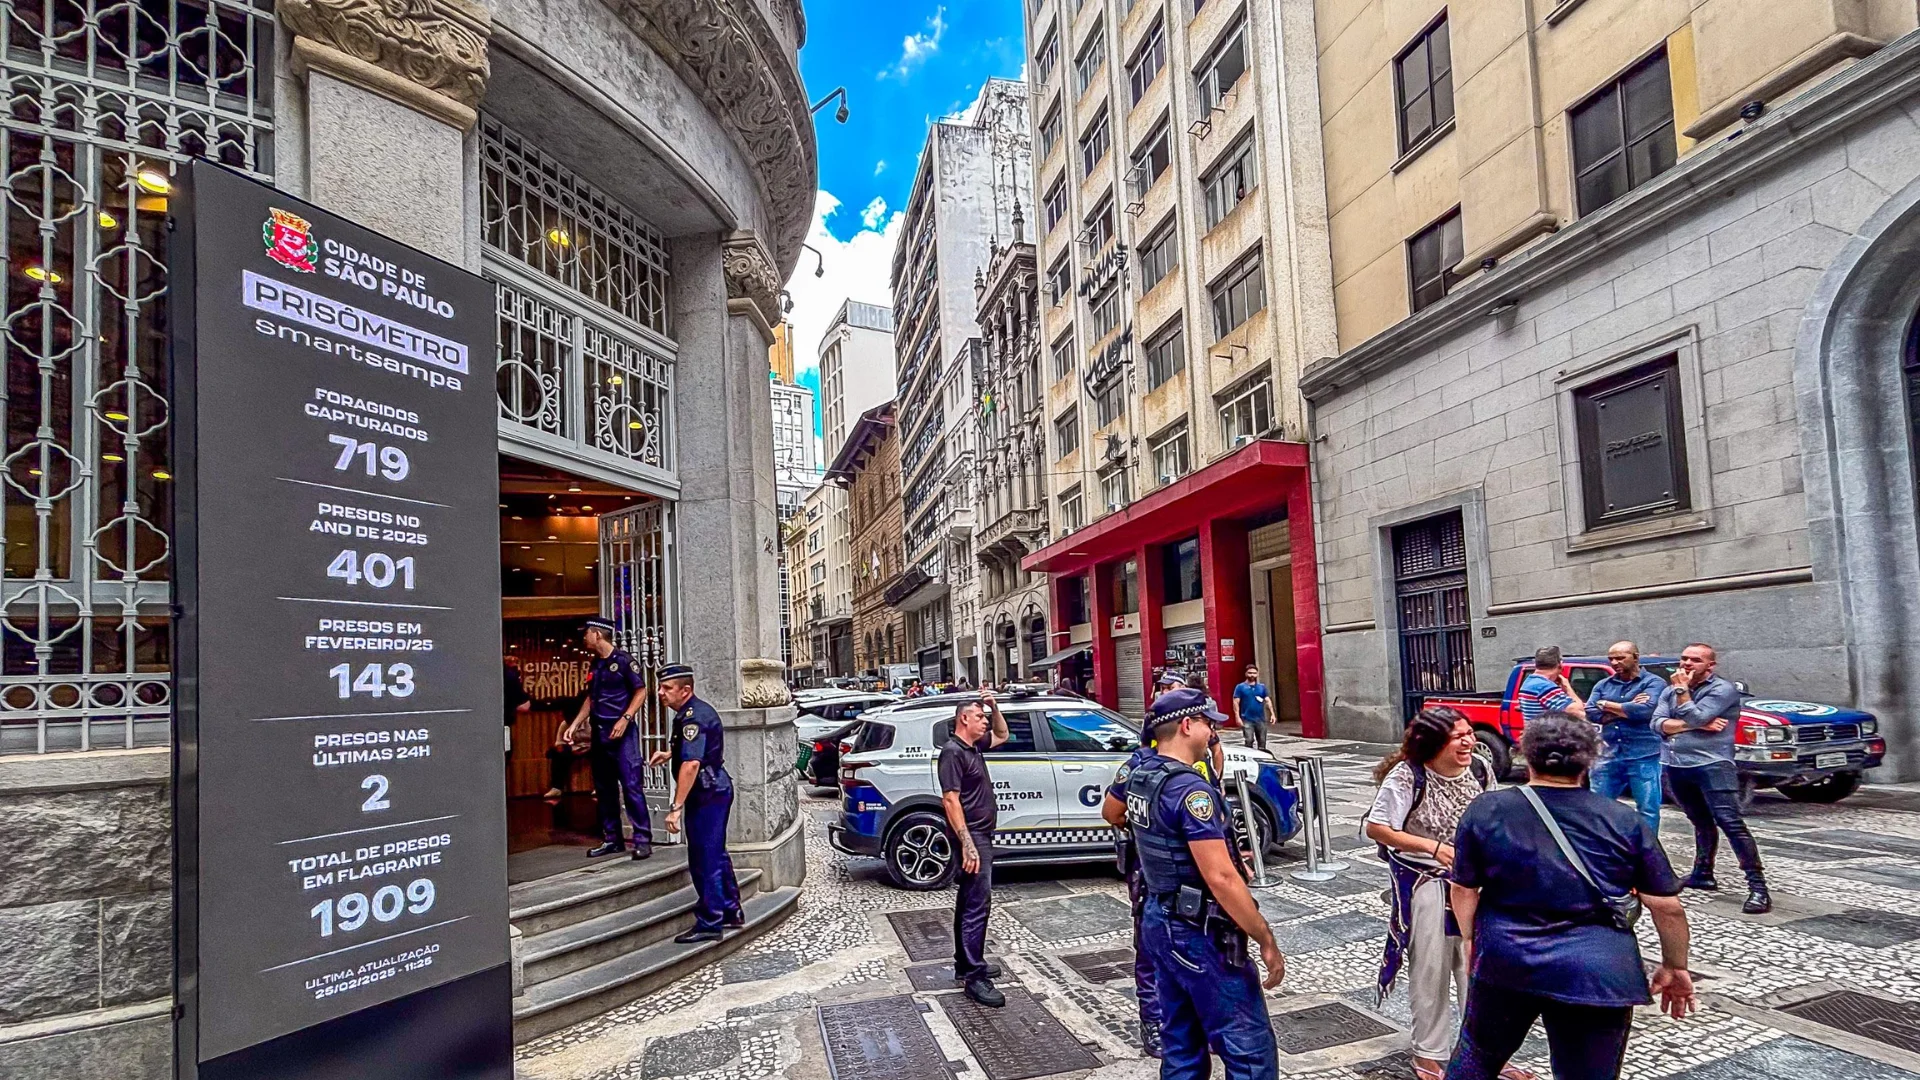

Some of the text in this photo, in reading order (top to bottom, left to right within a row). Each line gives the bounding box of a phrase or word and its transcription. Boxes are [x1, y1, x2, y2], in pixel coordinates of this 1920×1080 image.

[324, 238, 426, 290] CIDADE DE
[324, 257, 455, 318] SÃO PAULO
[255, 281, 460, 365] PRISÔMETRO
[255, 318, 463, 391] smartsampa
[304, 403, 429, 442] CAPTURADOS
[315, 387, 419, 424] FORAGIDOS
[328, 433, 409, 482] 719
[309, 519, 428, 546] ANO DE 2025
[318, 502, 421, 528] PRESOS NO
[326, 549, 415, 590] 401
[305, 636, 433, 651] FEVEREIRO/25
[318, 618, 422, 635] PRESOS EM
[329, 662, 415, 699] 143
[312, 745, 431, 767] ÚLTIMAS 24H
[314, 728, 429, 748] PRESOS NAS
[360, 773, 391, 812] 2
[1127, 794, 1147, 818] GCM
[288, 833, 451, 873] TOTAL DE PRESOS
[303, 851, 441, 890] EM FLAGRANTE
[310, 877, 436, 938] 1909
[305, 943, 441, 990] ULTIMA ATUALIZAÇÃO
[315, 967, 396, 1000] 25/02/2025
[404, 956, 433, 972] 11:25
